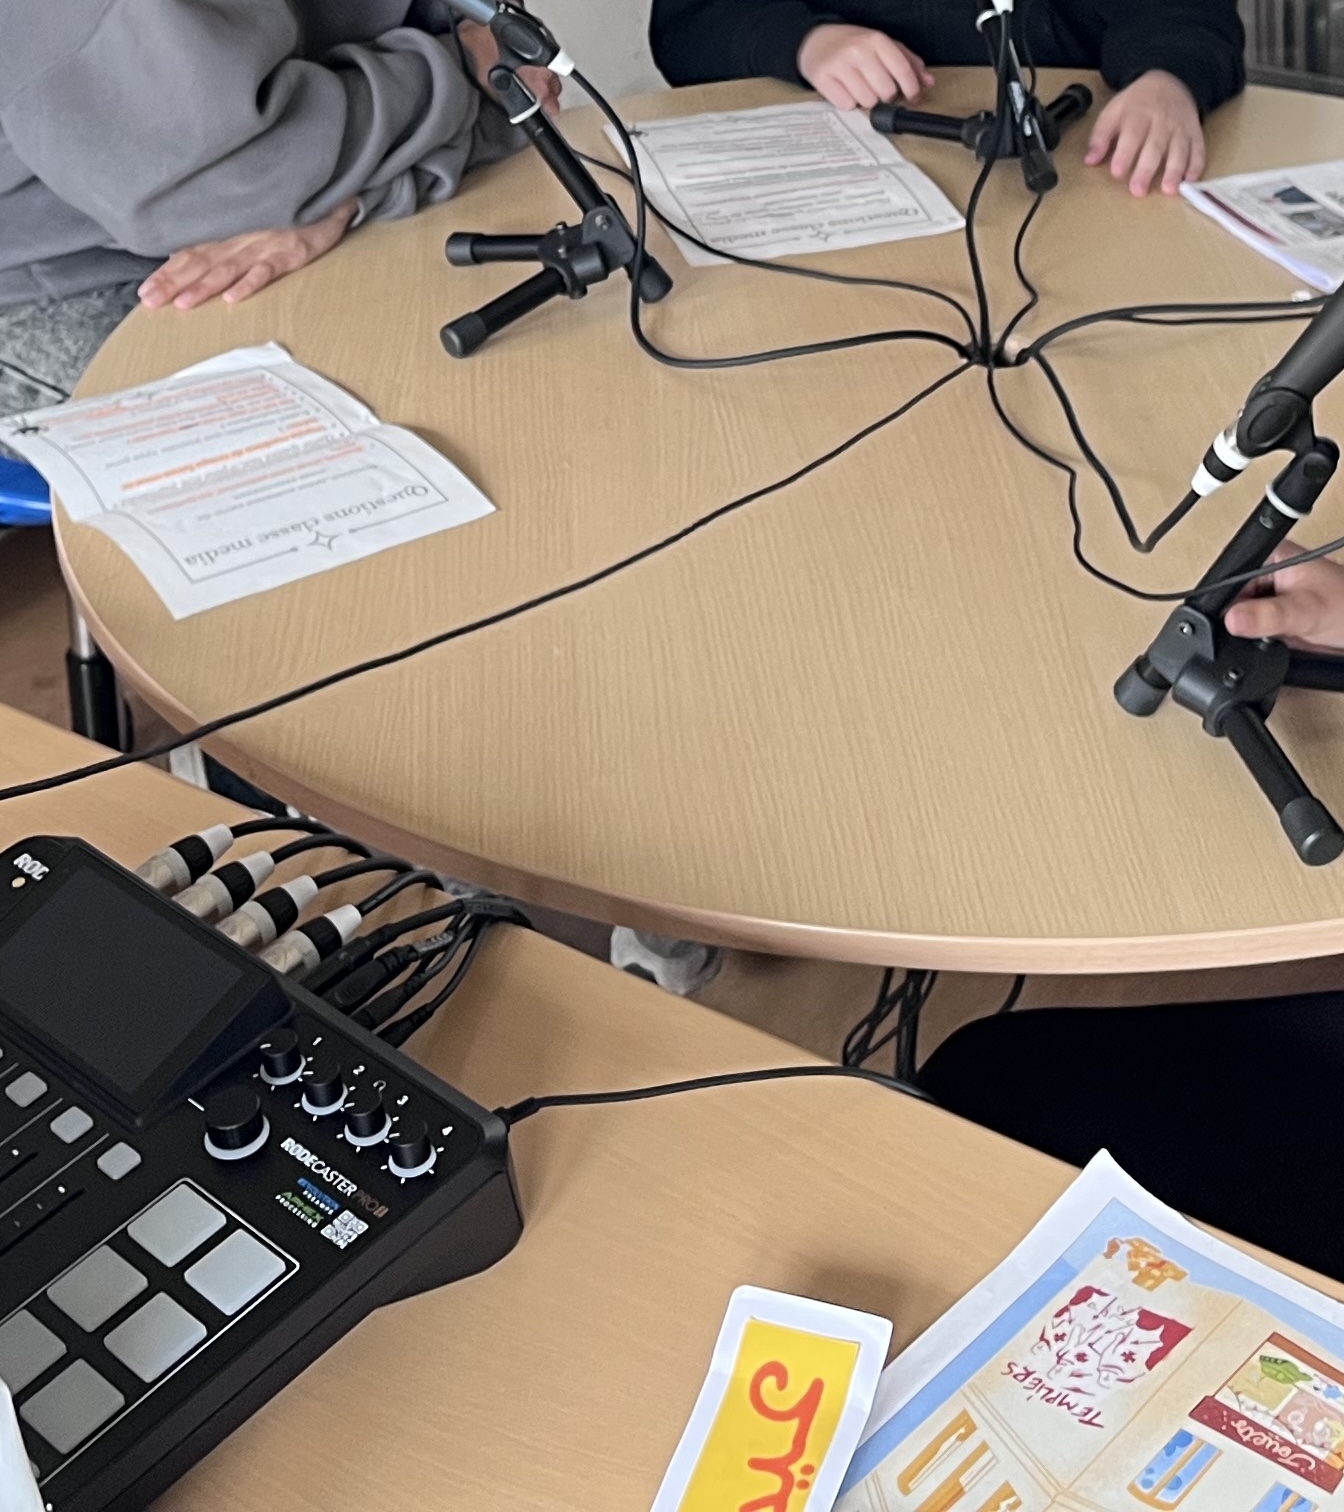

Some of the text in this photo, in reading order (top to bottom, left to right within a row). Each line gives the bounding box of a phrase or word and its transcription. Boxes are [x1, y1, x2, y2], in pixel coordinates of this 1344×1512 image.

[183, 483, 429, 567] Questions classe media
[1000, 1361, 1105, 1430] TEMPLIERS
[1230, 1417, 1317, 1471] Jouets
